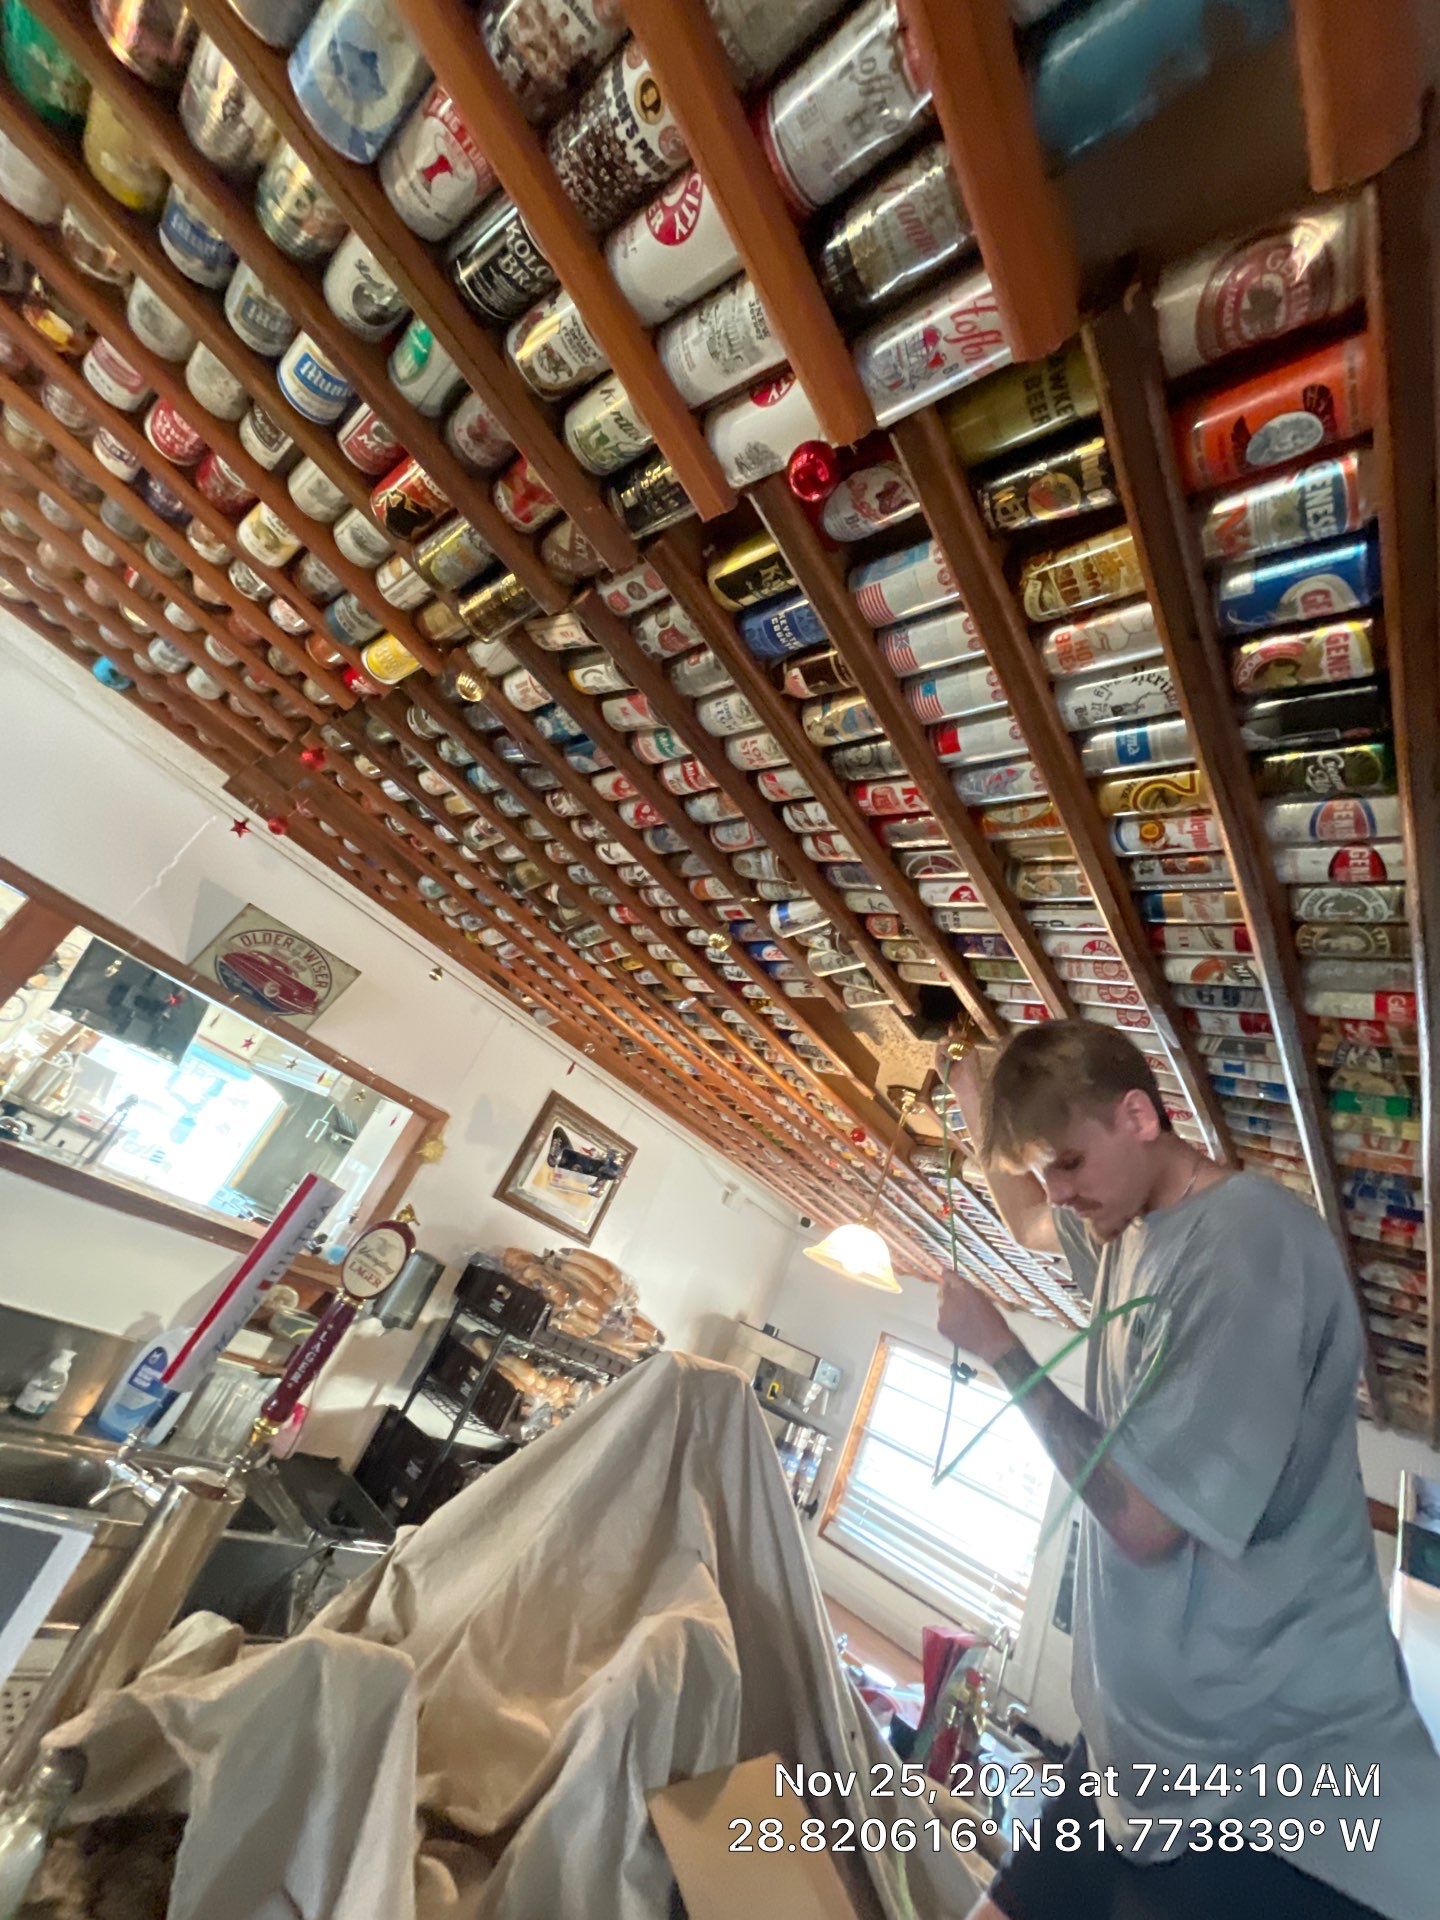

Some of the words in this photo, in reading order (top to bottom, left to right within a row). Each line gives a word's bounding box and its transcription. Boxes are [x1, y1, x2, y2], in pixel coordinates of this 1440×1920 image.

[674, 172, 702, 241] CITY
[239, 931, 294, 949] OLDER
[303, 949, 330, 990] WISER
[347, 1260, 382, 1289] LAGER
[292, 1330, 334, 1384] LAGER
